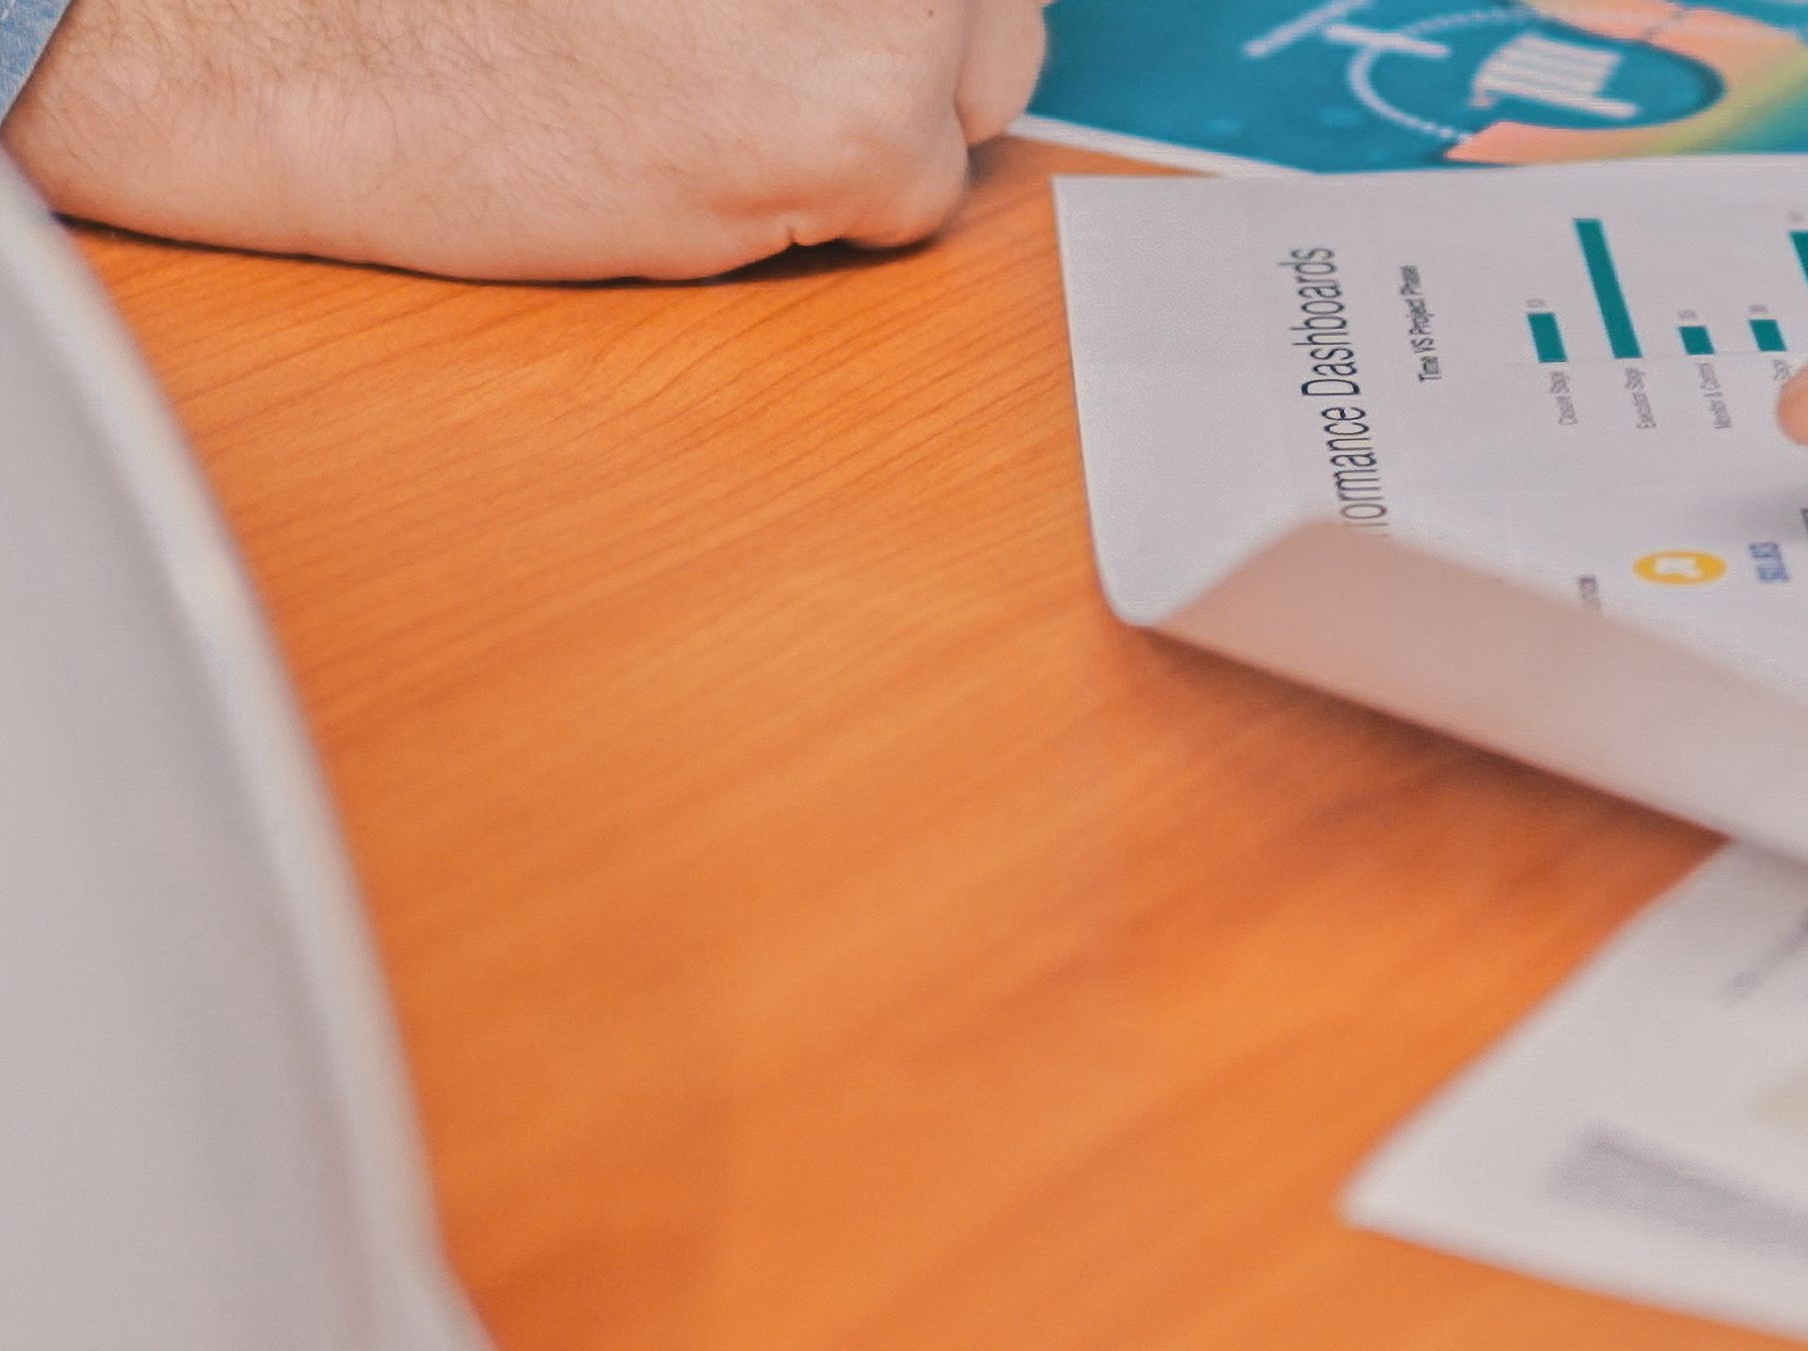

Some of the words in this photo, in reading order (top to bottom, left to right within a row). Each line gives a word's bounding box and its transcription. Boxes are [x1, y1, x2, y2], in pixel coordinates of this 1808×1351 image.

[1278, 247, 1362, 397] Dashboards
[1405, 297, 1436, 336] Project
[1410, 337, 1437, 354] VS
[1416, 355, 1442, 383] Time
